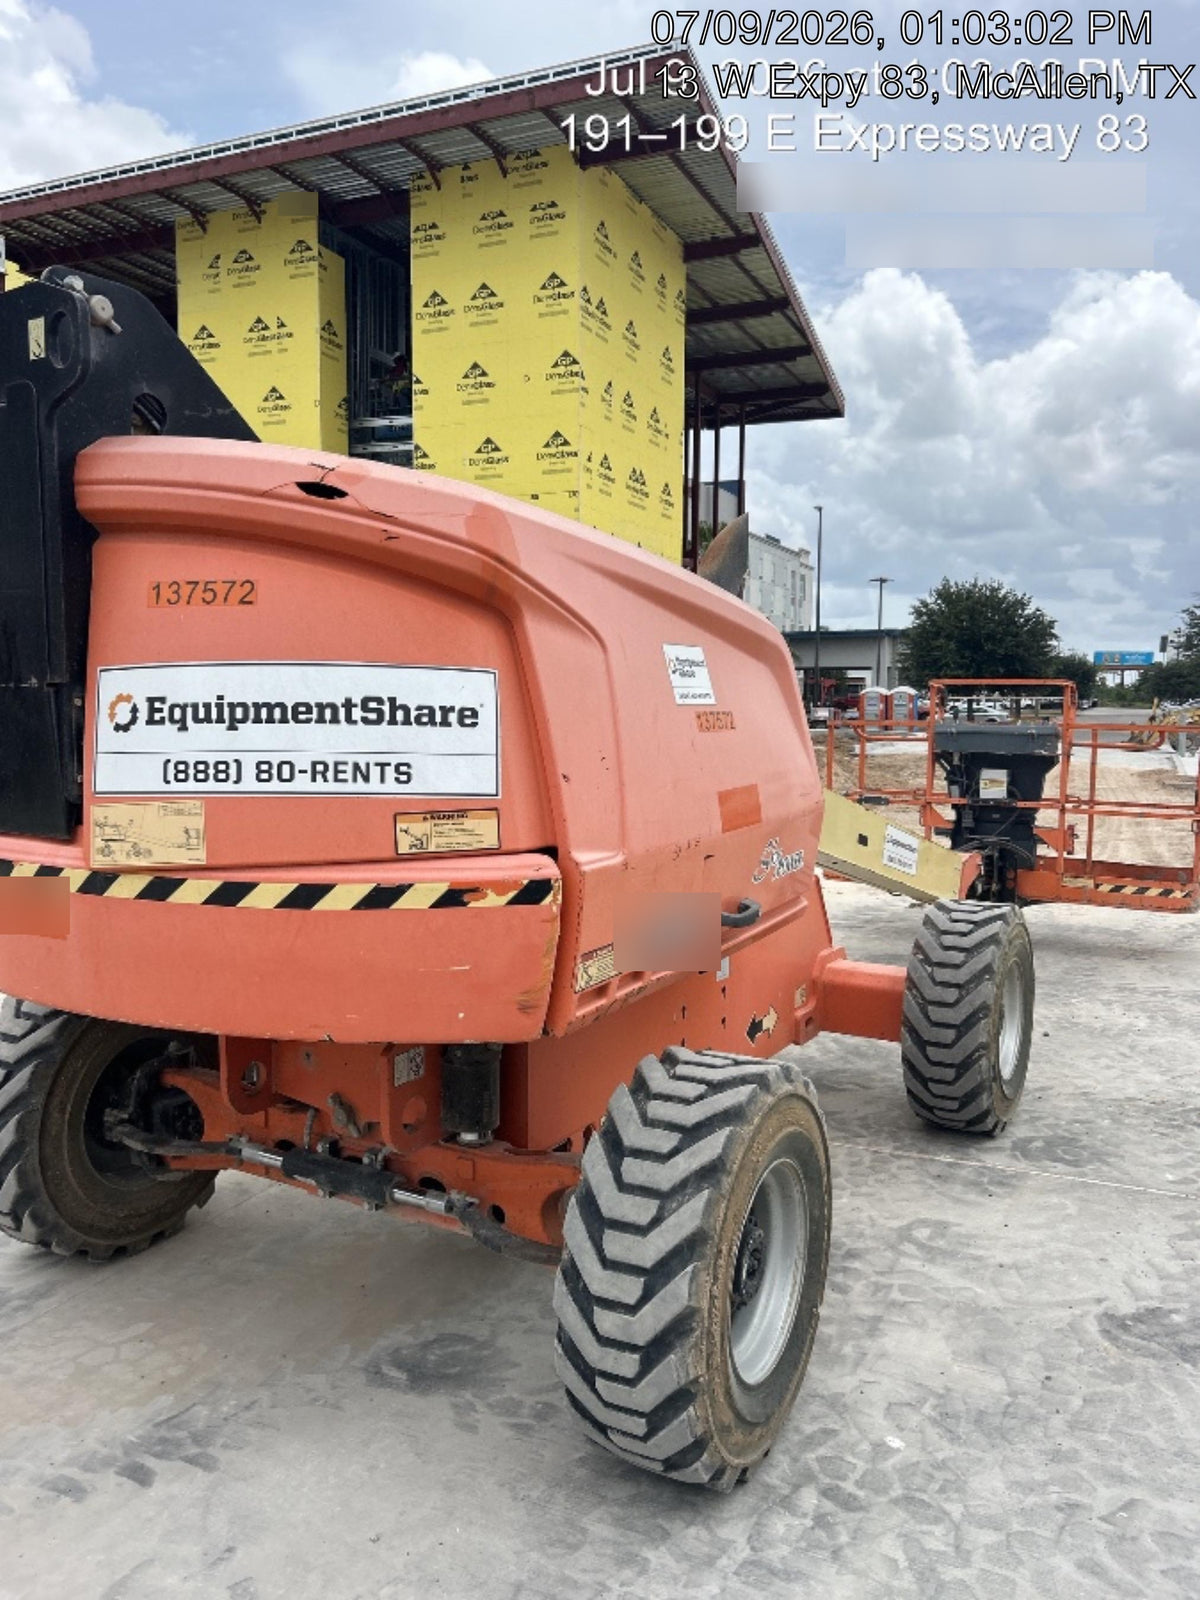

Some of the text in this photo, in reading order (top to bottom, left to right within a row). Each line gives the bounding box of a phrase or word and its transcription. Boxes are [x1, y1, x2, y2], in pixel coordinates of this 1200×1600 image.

[150, 580, 255, 605] 137572
[145, 695, 480, 732] EquipmentShare
[162, 759, 413, 785] (888) 80-RENTS
